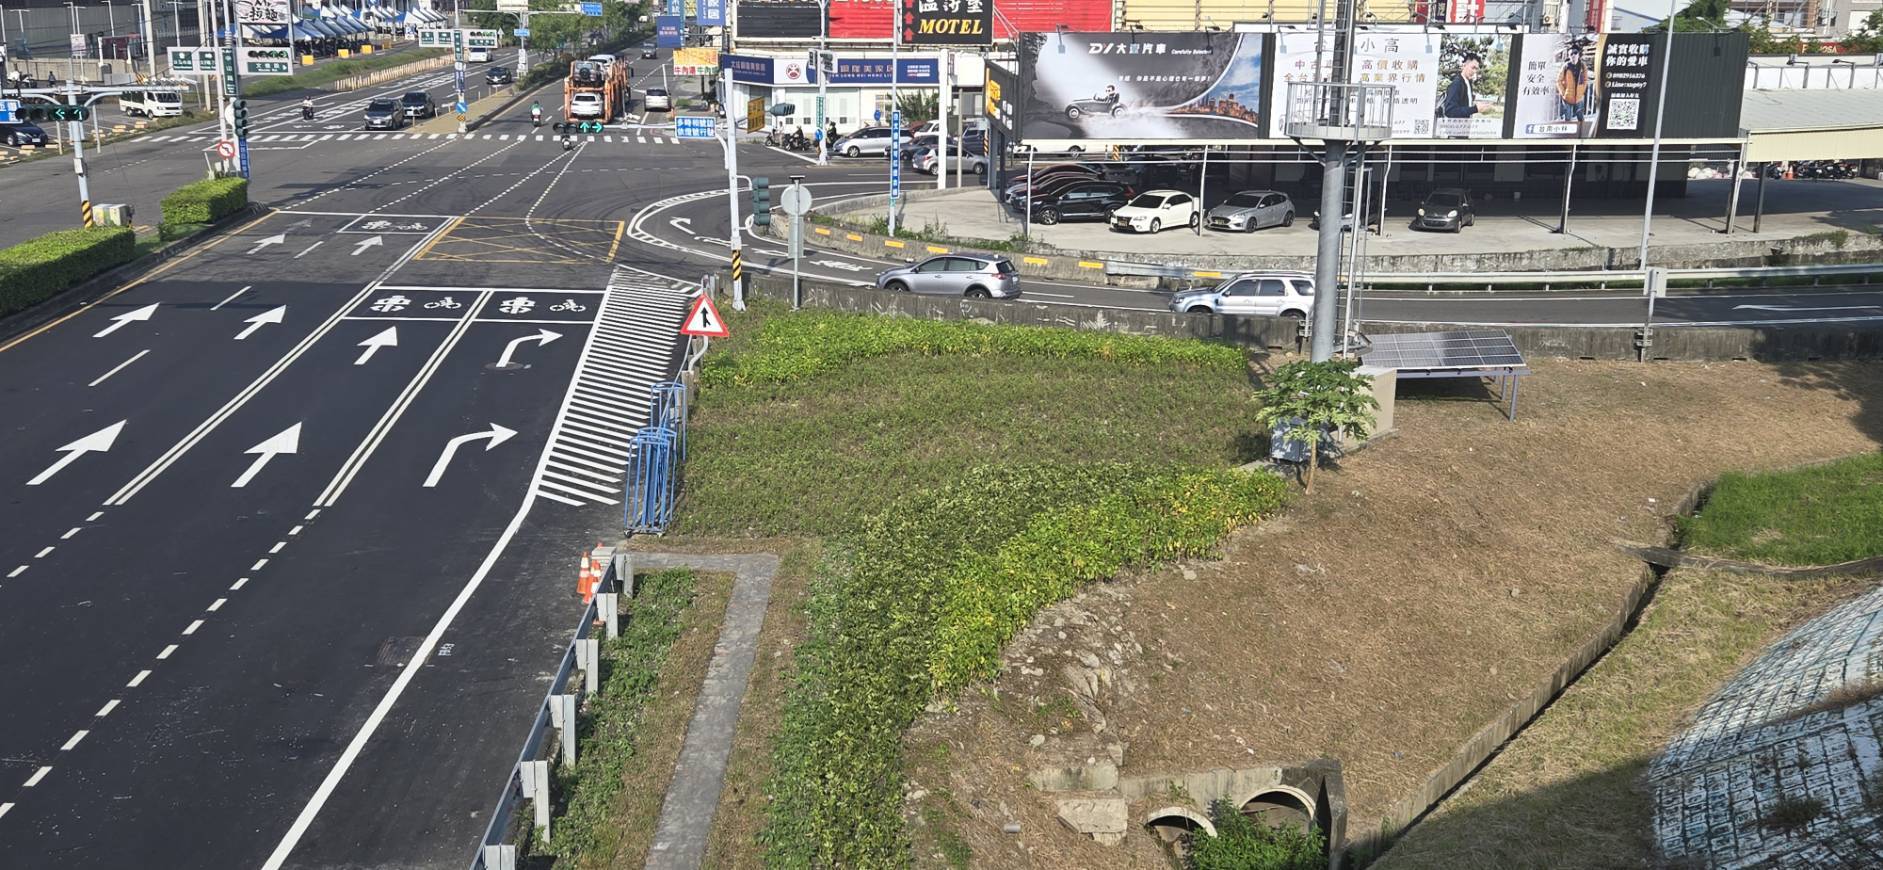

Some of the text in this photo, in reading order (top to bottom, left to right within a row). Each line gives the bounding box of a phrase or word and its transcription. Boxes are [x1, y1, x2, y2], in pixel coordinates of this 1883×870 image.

[919, 19, 983, 34] MOTEL
[1606, 43, 1650, 55] 誠實收購
[1802, 44, 1838, 54] FOSA
[1362, 60, 1418, 71] 高價收購
[1528, 60, 1547, 71] 簡單
[1605, 56, 1649, 67] 你的愛車
[1526, 74, 1546, 84] 安全
[1522, 86, 1550, 97] 有效率
